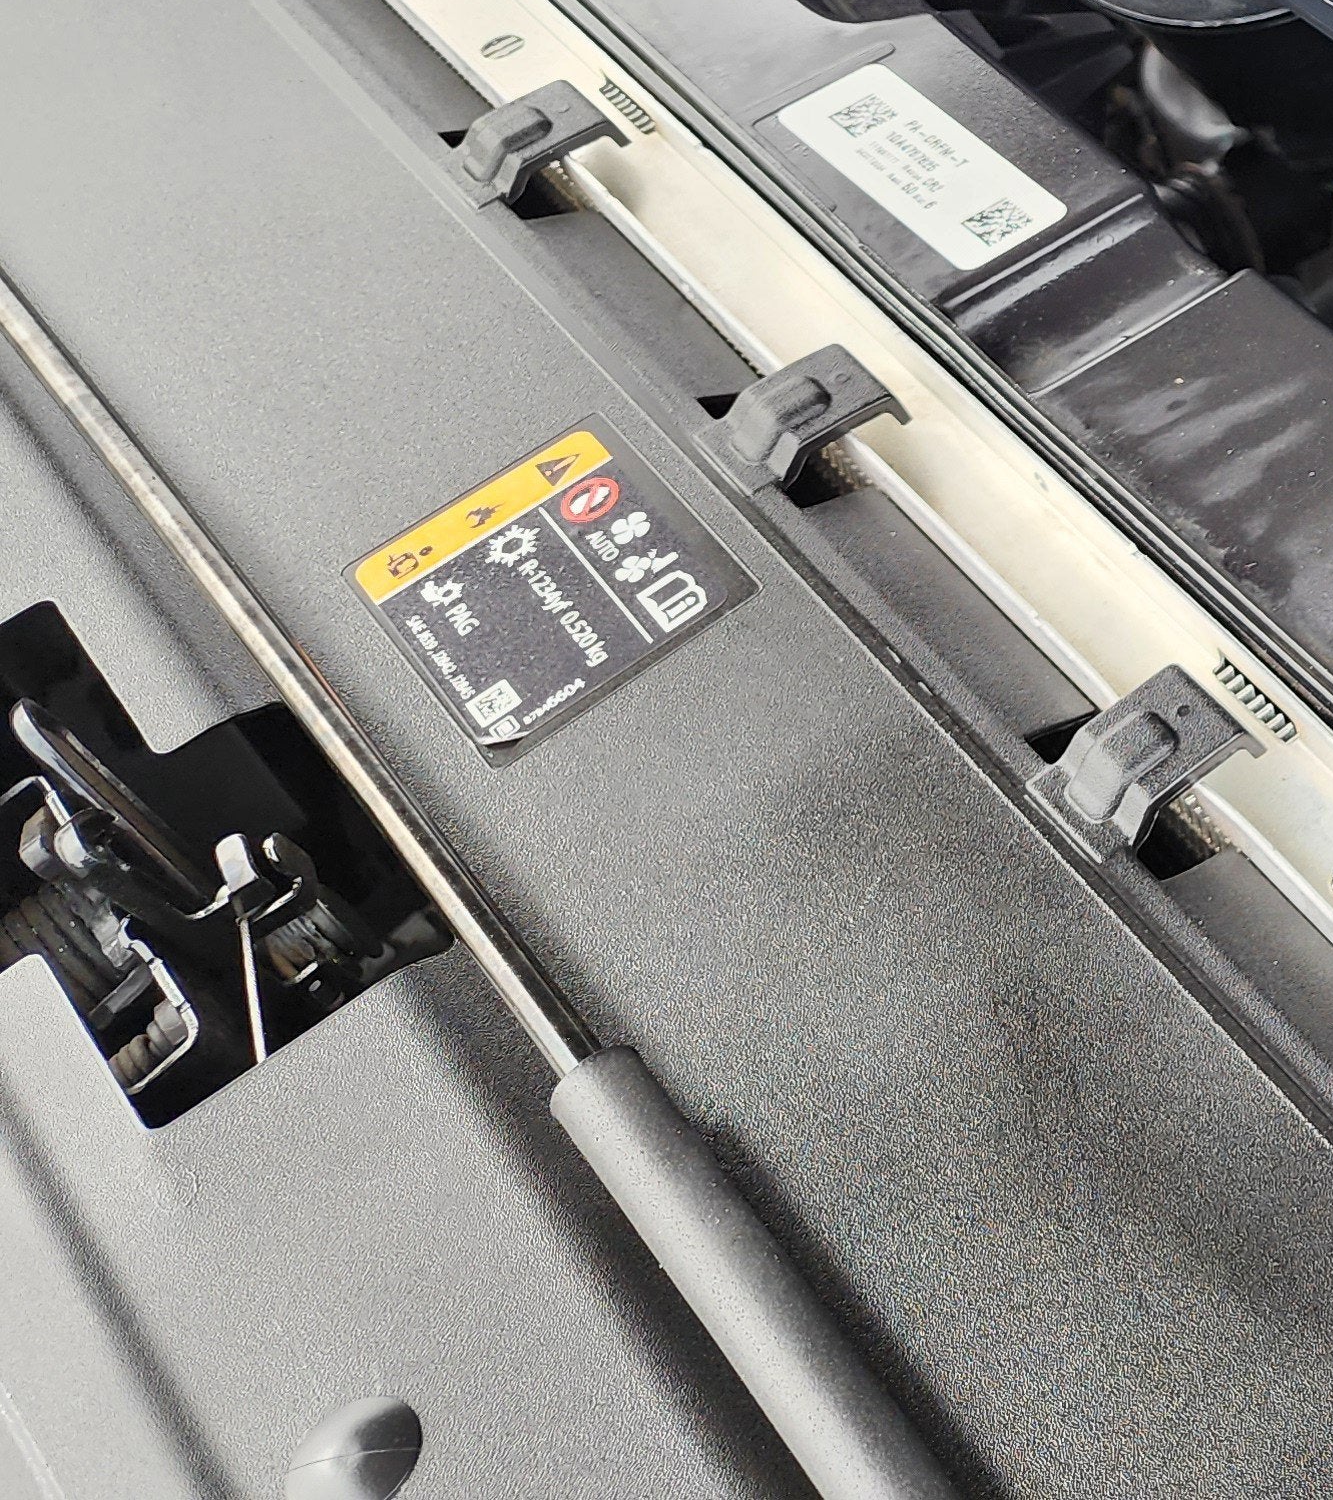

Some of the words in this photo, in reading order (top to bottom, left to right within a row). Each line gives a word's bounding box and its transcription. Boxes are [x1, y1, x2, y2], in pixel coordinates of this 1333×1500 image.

[584, 530, 620, 562] AUTO
[405, 614, 427, 635] SAE
[444, 602, 480, 637] PAG
[517, 558, 574, 614] R-1234yf
[583, 640, 609, 668] kg
